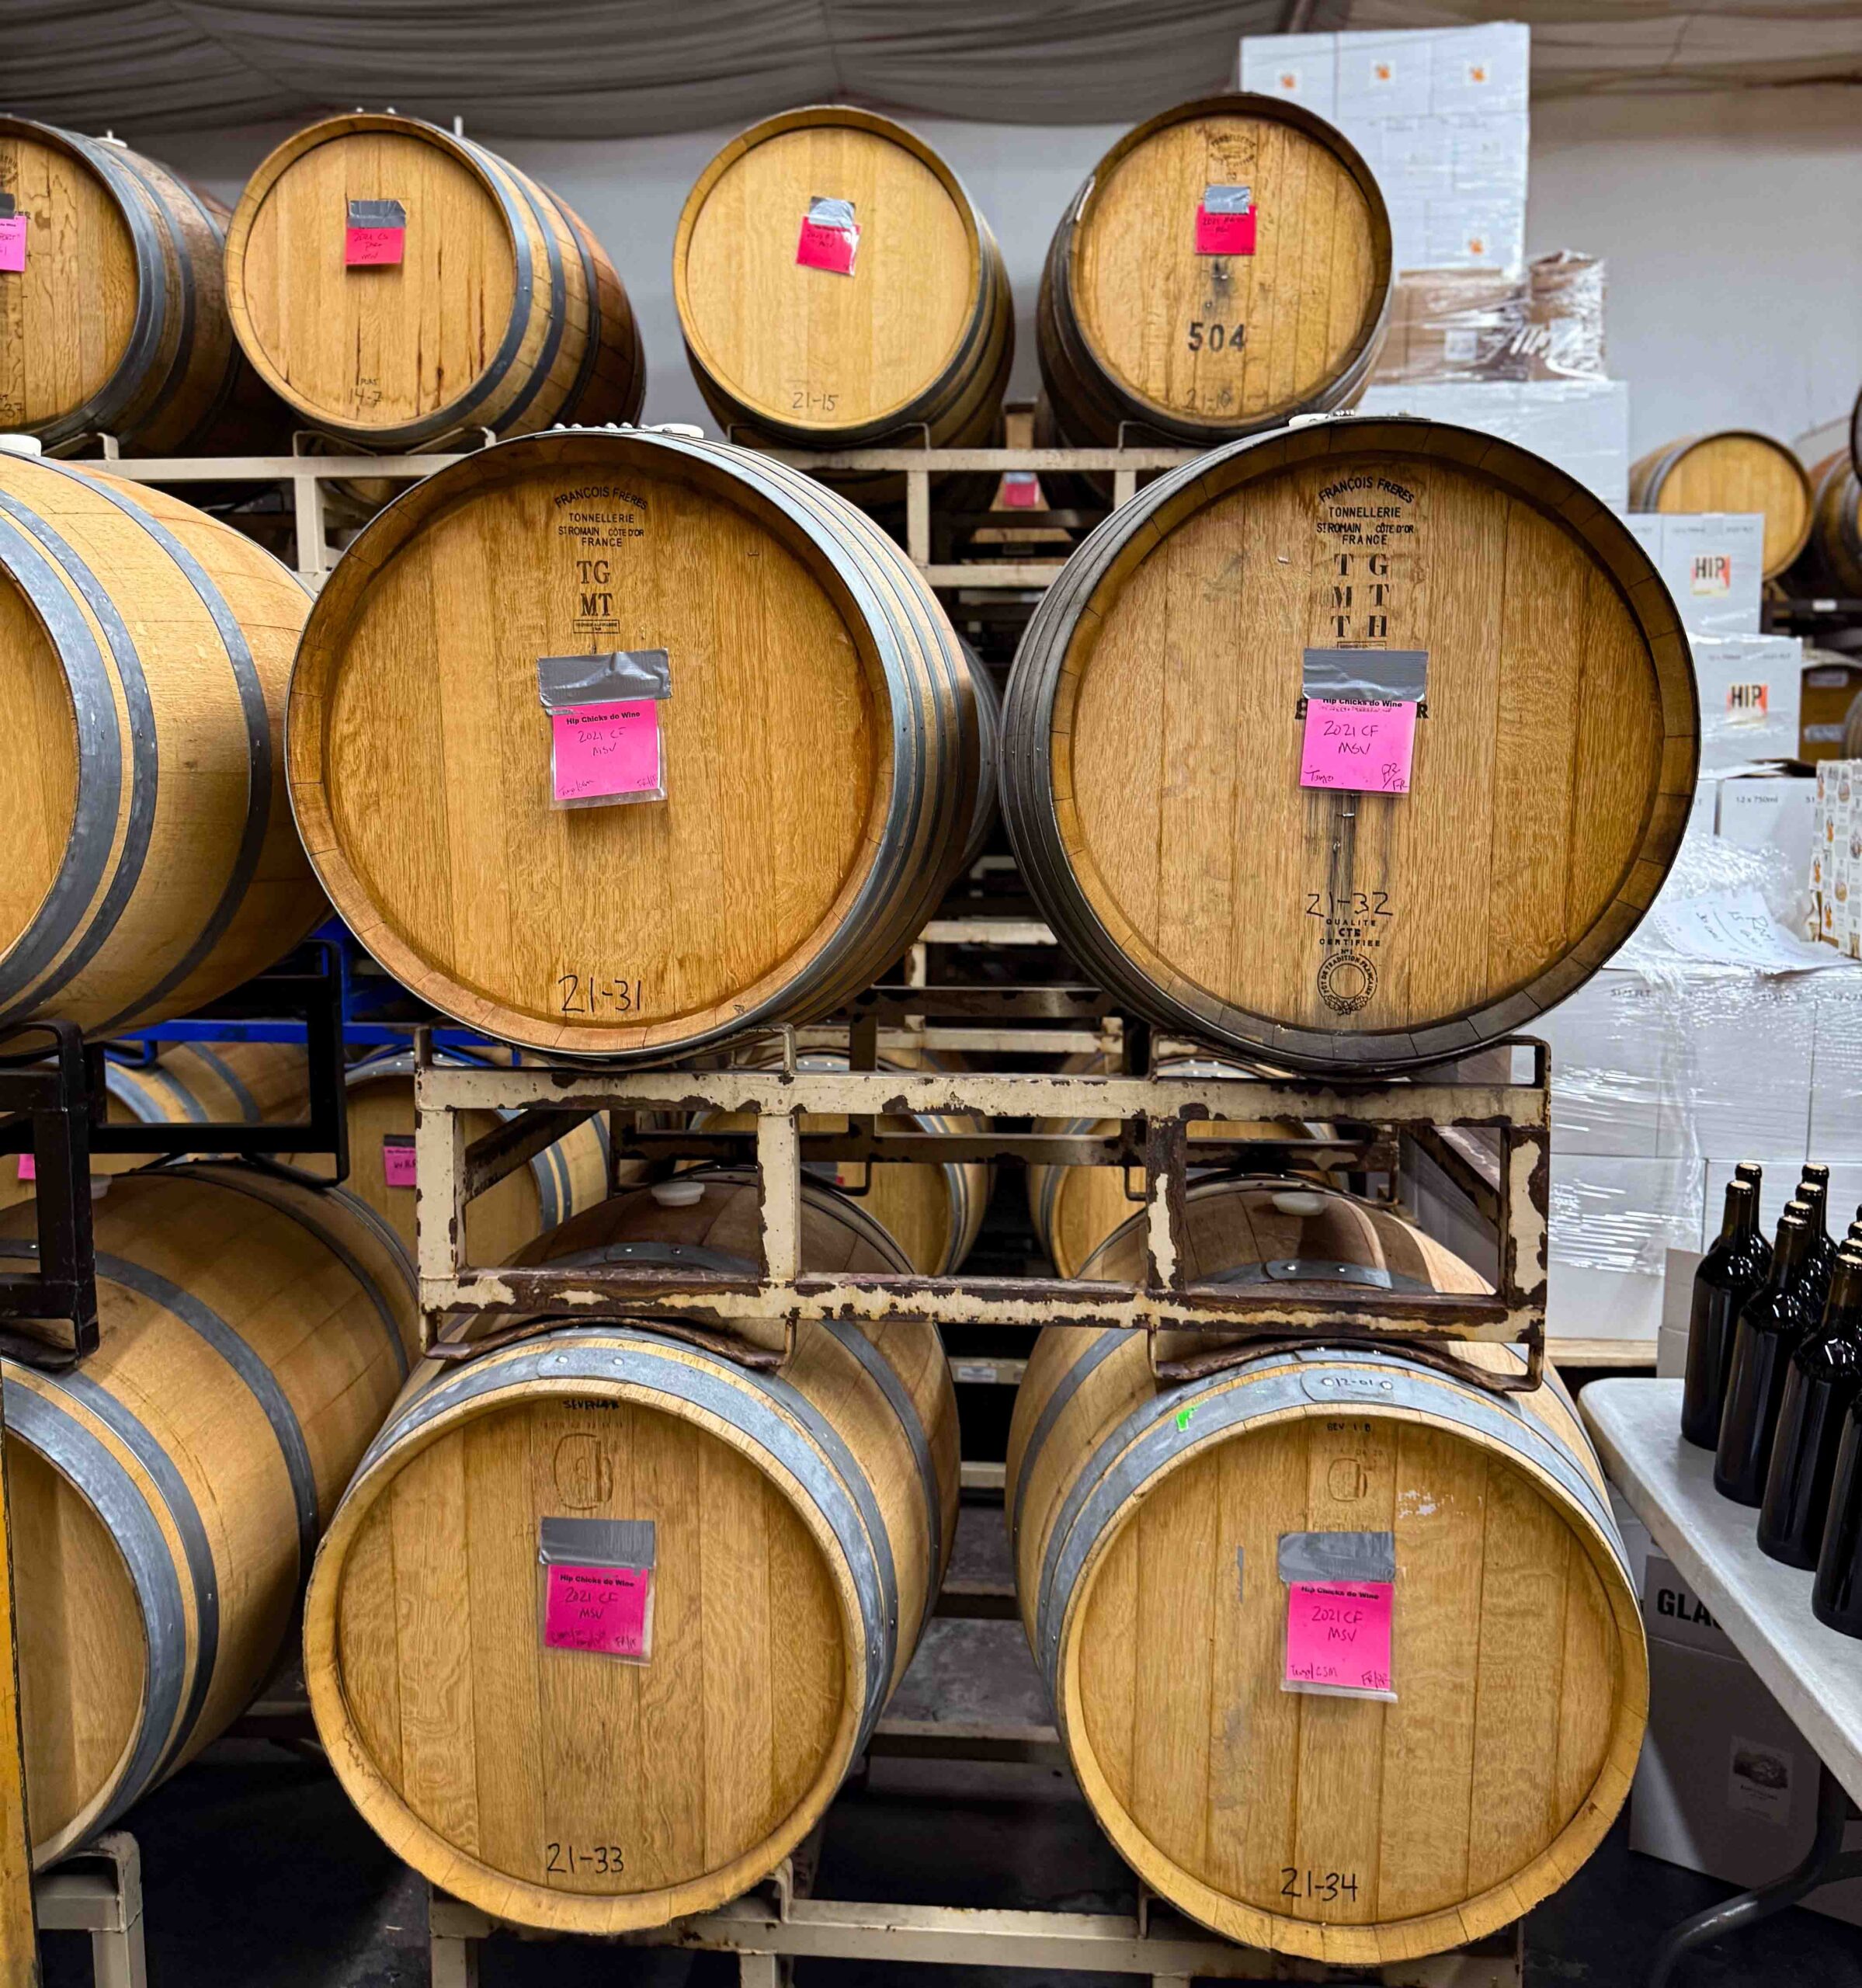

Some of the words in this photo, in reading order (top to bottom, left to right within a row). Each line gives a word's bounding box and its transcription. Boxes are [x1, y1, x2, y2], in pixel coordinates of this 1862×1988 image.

[1188, 321, 1245, 353] 504
[349, 388, 382, 408] 14-7
[793, 391, 839, 412] 21-15
[612, 487, 648, 510] FRERES
[1318, 476, 1374, 502] FRANÇOIS
[1377, 478, 1415, 504] FRERES
[569, 513, 635, 523] TONNELLERIE
[1329, 506, 1402, 518] TONNELLERIE
[1396, 524, 1414, 533] D'OR
[582, 537, 623, 547] FRANCE
[1342, 534, 1388, 545] FRANCE
[576, 561, 610, 584] TG
[1695, 557, 1725, 580] HIP
[580, 593, 613, 617] MT
[1731, 685, 1762, 708] HIP
[582, 714, 608, 722] Chicks
[621, 711, 641, 719] Wine
[578, 730, 603, 743] 2021
[1323, 720, 1356, 737] 2021
[1361, 725, 1379, 737] CF
[1338, 742, 1371, 755] MSV
[1306, 891, 1394, 917] 21-32
[558, 974, 641, 1013] 21-31
[575, 1576, 601, 1584] Chicks
[565, 1587, 592, 1603] 2021
[598, 1592, 619, 1604] CF
[1301, 1586, 1315, 1594] Hip
[1317, 1587, 1345, 1597] Chicks
[578, 1608, 603, 1619] MSV
[1311, 1606, 1340, 1622] 2021
[1343, 1611, 1363, 1624] CF
[1658, 1589, 1723, 1631] GLA
[1328, 1627, 1357, 1642] MSV
[547, 1843, 624, 1874] 21-33
[1280, 1868, 1358, 1902] 21-34
